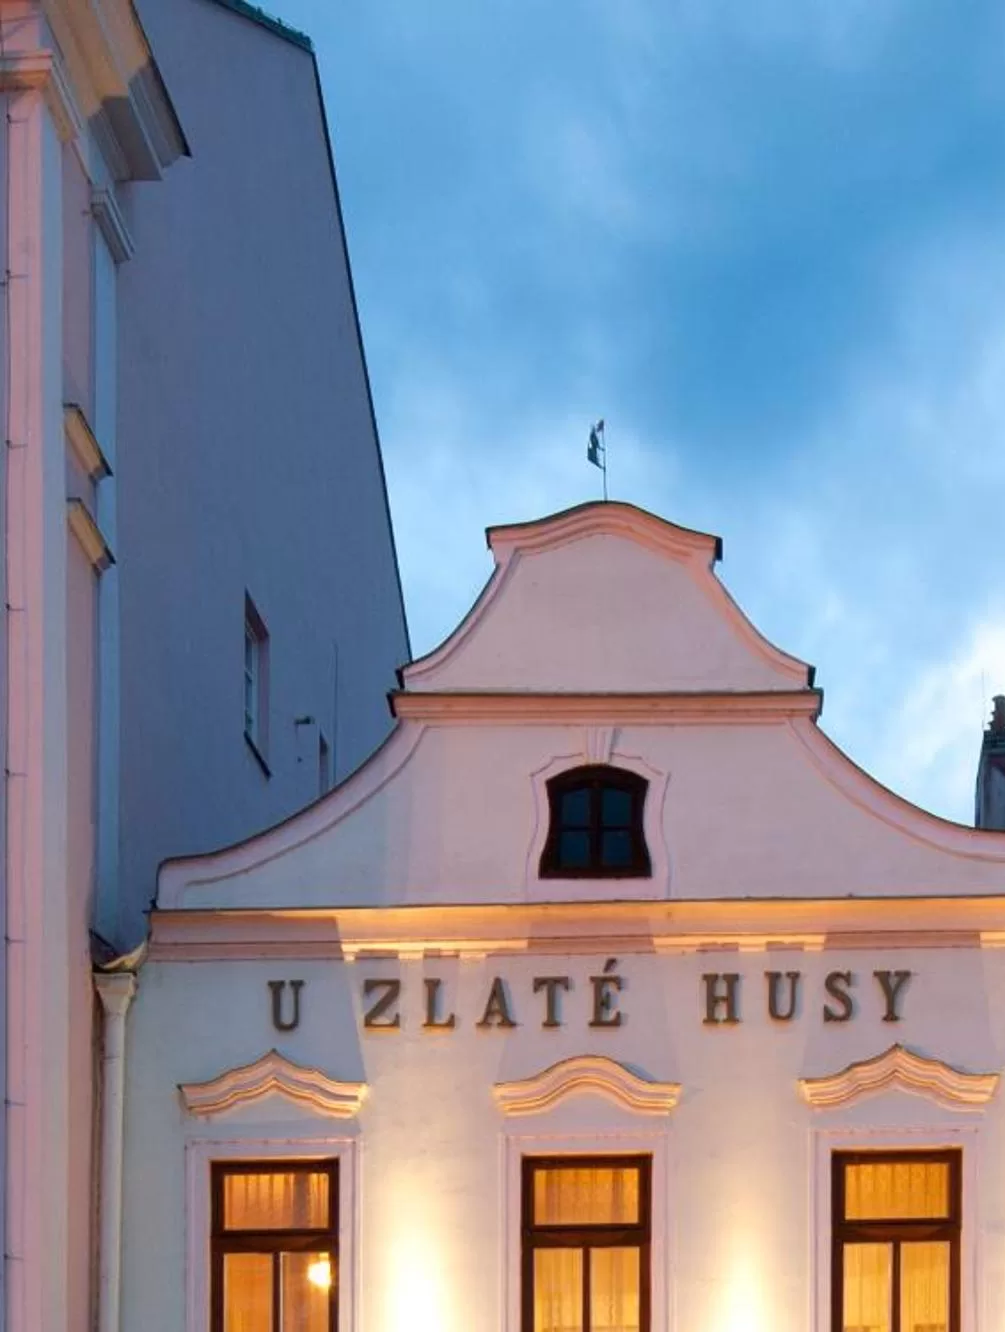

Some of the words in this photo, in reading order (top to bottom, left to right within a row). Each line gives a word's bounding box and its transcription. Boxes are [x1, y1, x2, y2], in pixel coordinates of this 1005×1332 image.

[267, 979, 305, 1032] U
[363, 958, 622, 1027] ZLATÉ
[702, 969, 912, 1024] HUSY
